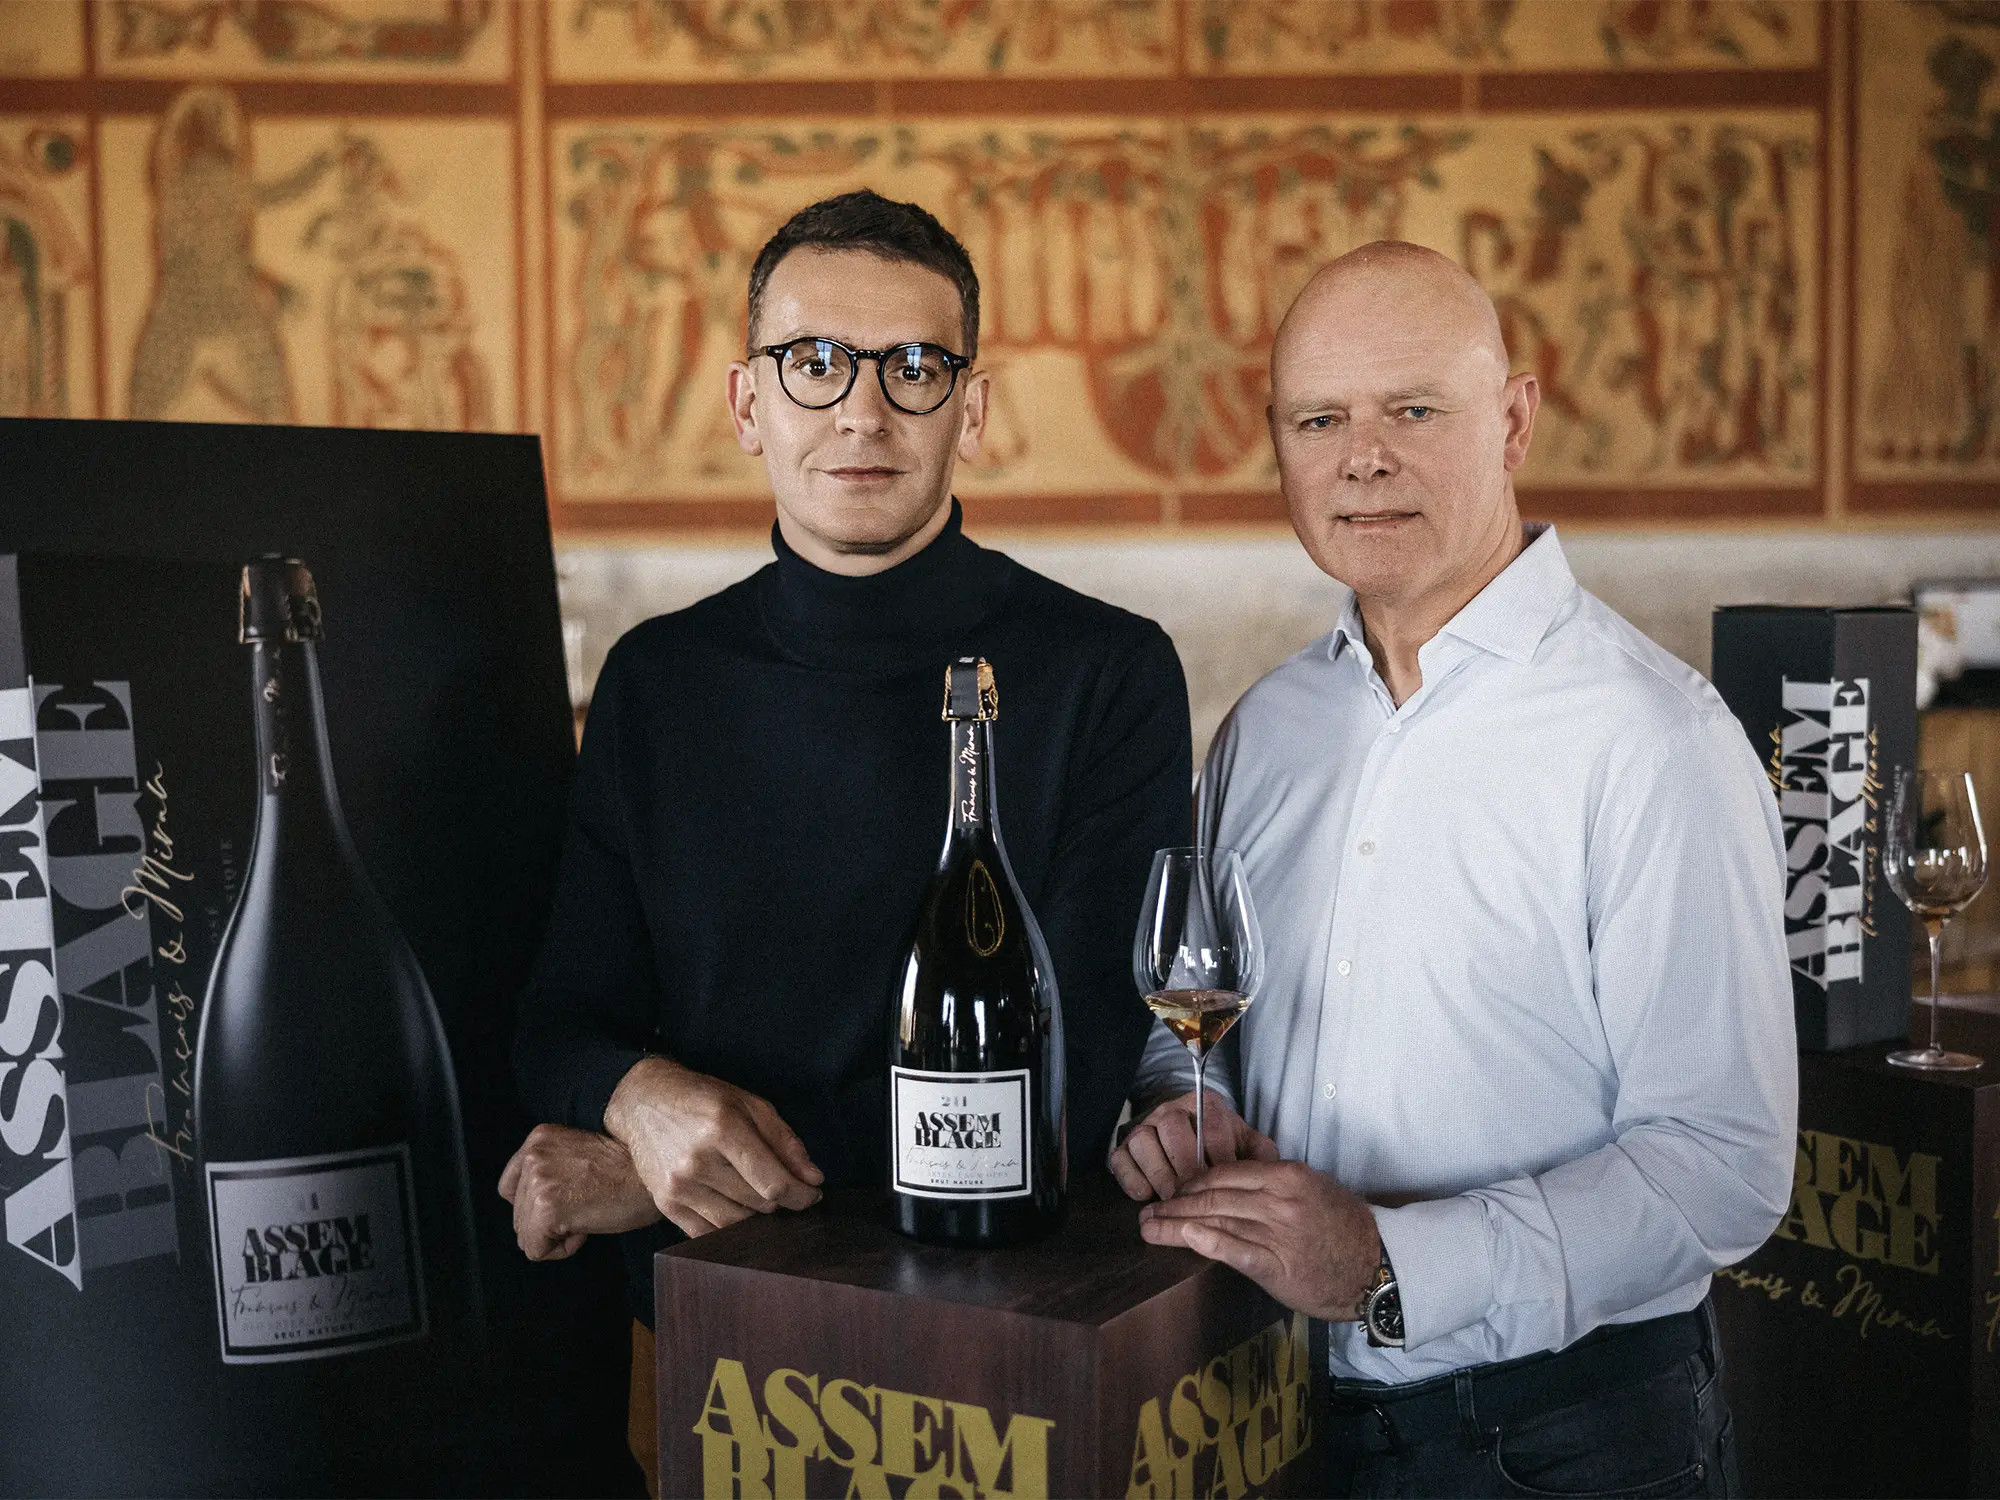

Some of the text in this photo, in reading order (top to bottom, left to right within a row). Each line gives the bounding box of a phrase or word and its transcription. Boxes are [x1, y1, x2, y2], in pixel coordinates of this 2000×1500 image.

[1781, 674, 1832, 992] ASSEM
[1826, 675, 1870, 984] BLAGE
[157, 931, 188, 965] &
[33, 679, 181, 1267] BLAGE
[914, 1111, 1001, 1132] ASSEM
[915, 1129, 1001, 1149] BLAGE
[956, 1160, 966, 1170] &
[242, 1214, 371, 1257] ASSEM
[244, 1241, 375, 1283] BLAGE
[1800, 1280, 1824, 1308] &
[1125, 1311, 1311, 1497] ASSEM
[692, 1357, 1057, 1497] ASSEM
